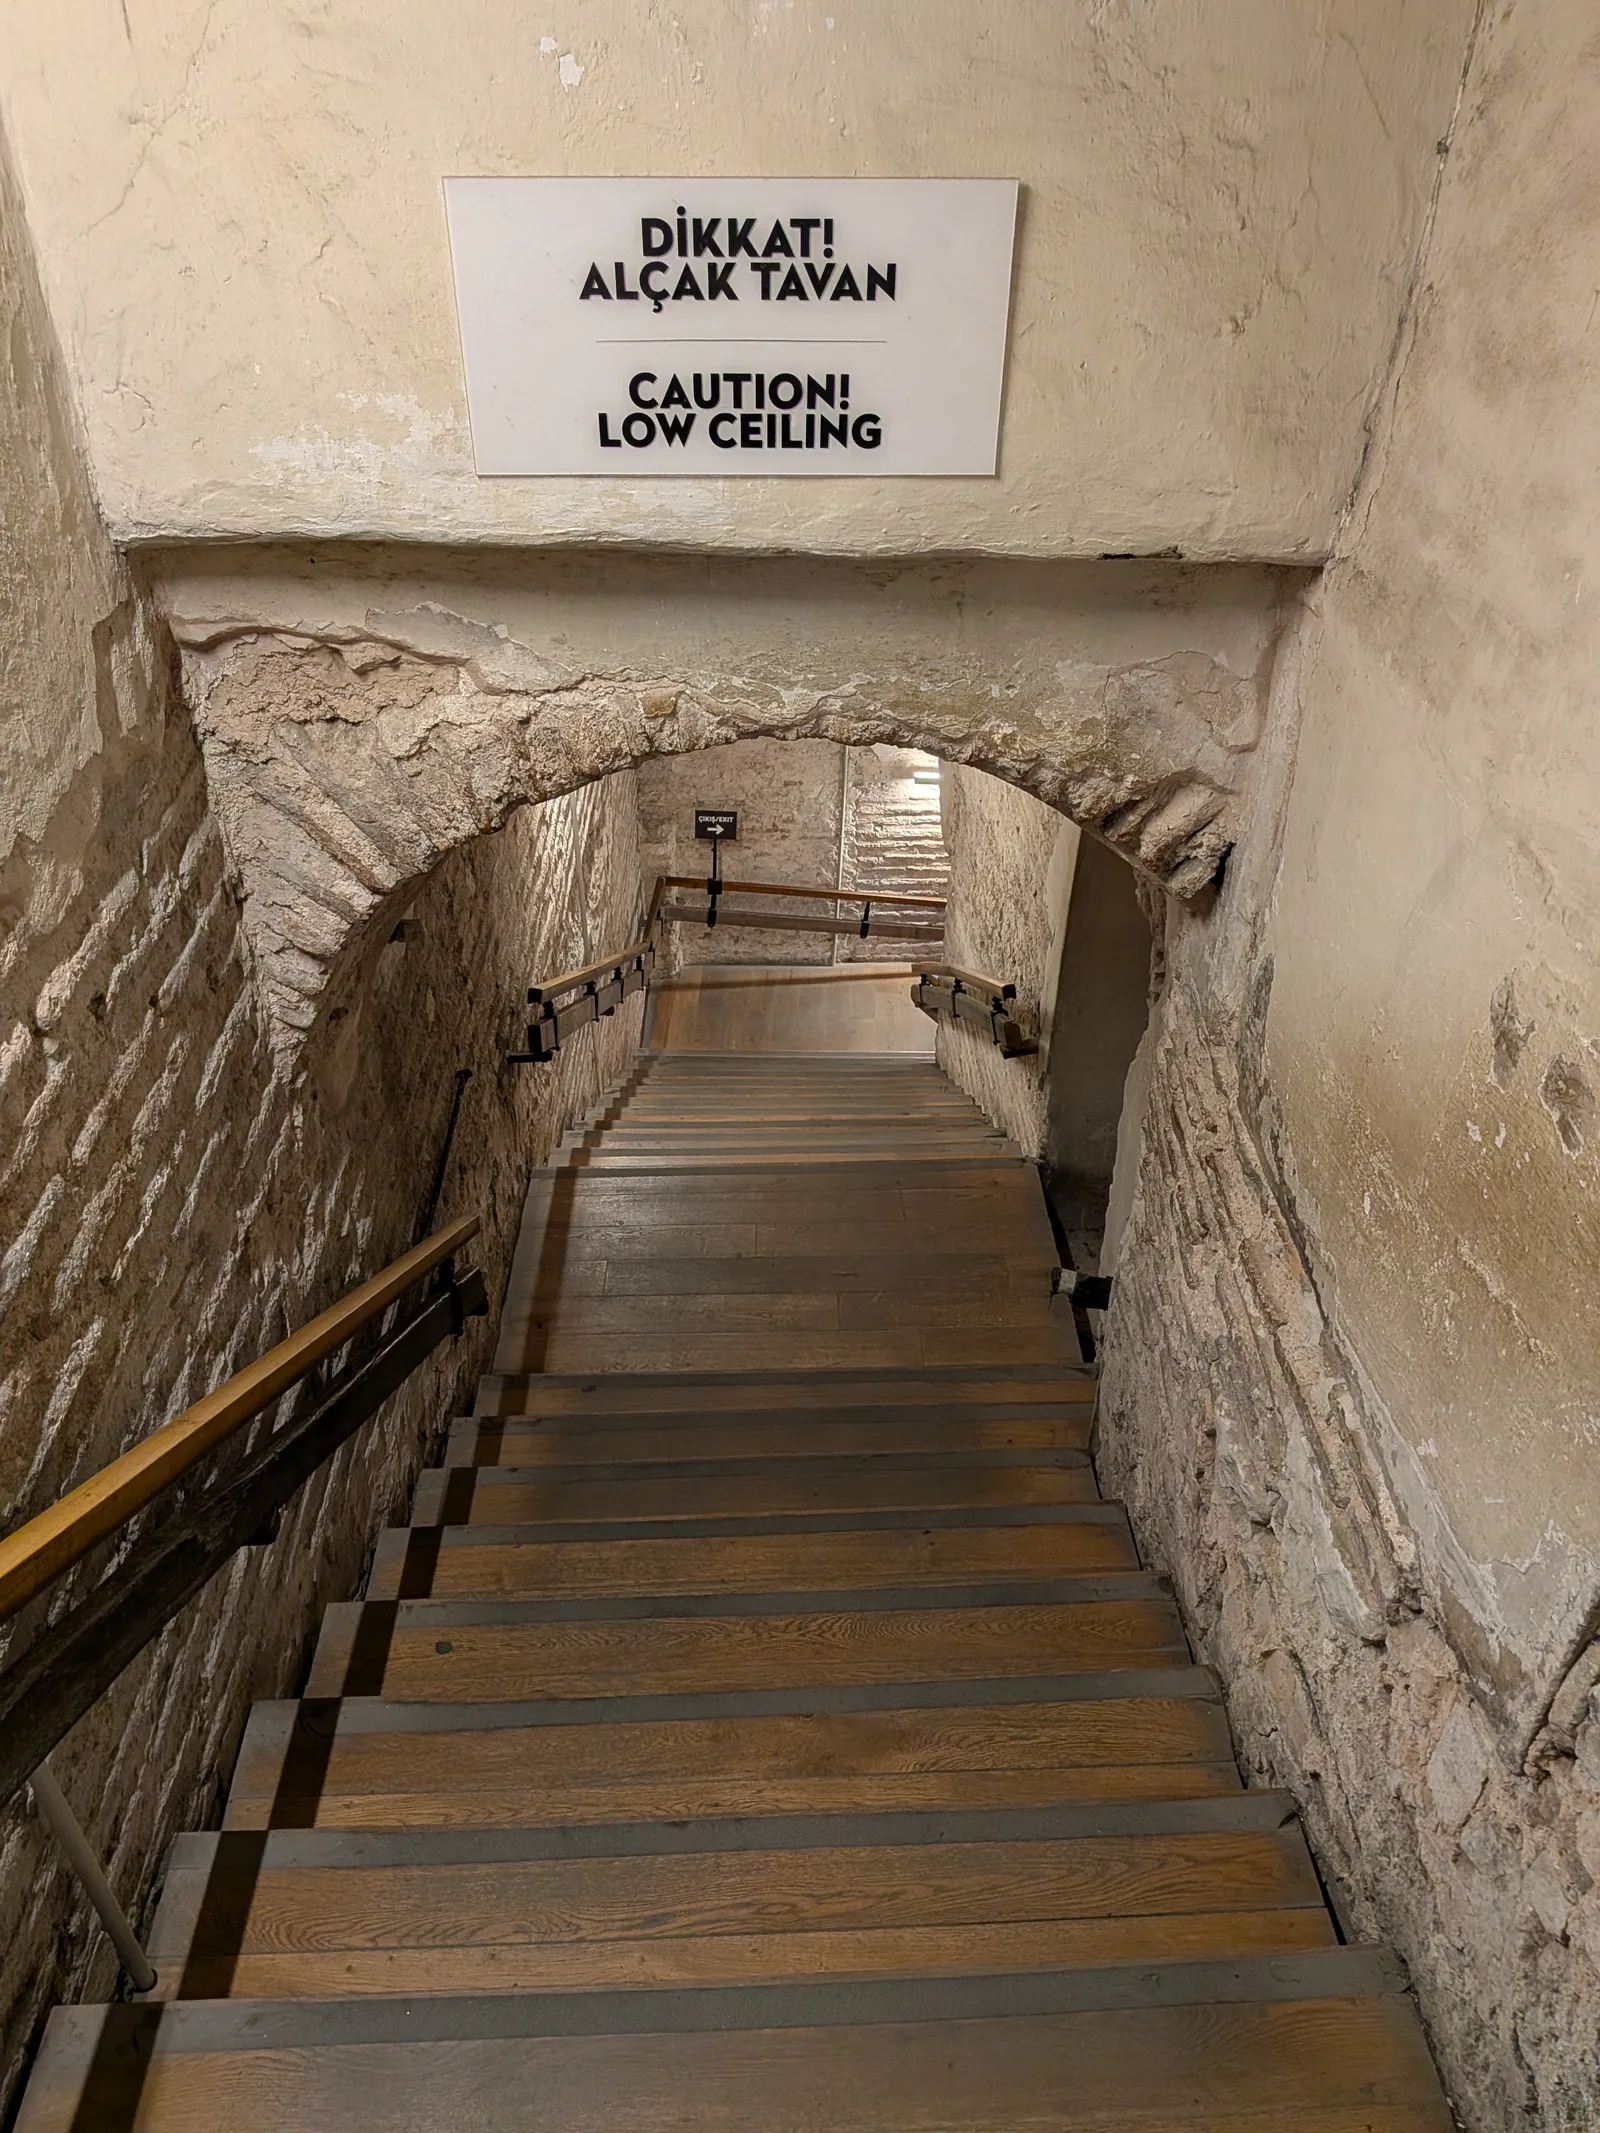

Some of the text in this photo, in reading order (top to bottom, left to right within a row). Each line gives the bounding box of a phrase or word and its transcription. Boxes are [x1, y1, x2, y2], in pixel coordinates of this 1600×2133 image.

[641, 205, 835, 259] DİKKAT!
[579, 261, 897, 314] ALÇAK TAVAN
[628, 372, 850, 411] CAUTION!
[598, 412, 882, 450] LOW CEILING
